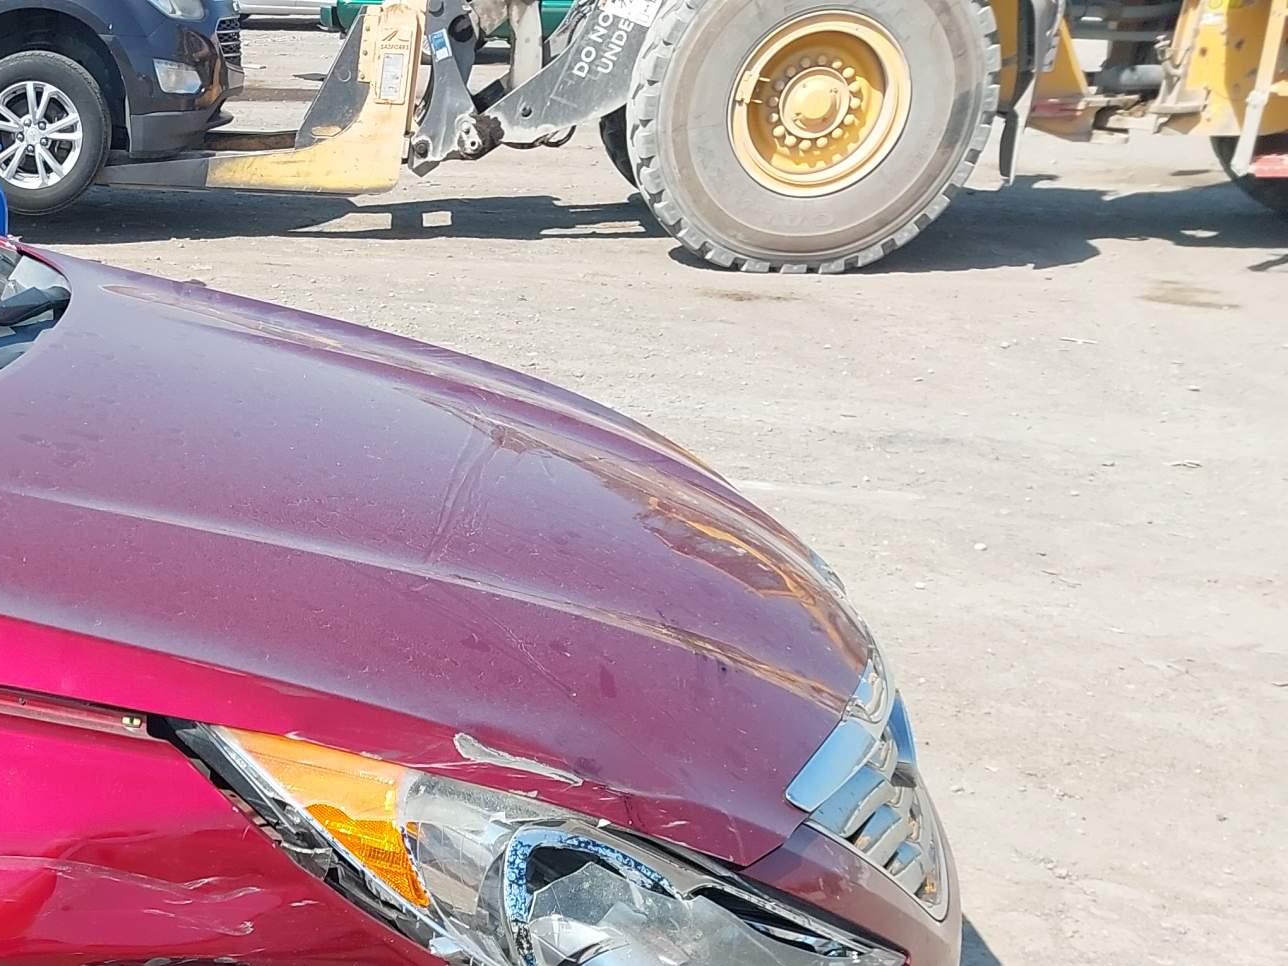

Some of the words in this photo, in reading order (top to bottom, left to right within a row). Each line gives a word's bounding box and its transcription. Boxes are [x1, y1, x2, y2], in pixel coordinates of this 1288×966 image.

[572, 46, 596, 78] DO
[588, 11, 614, 43] NO
[597, 18, 634, 74] UNDE
